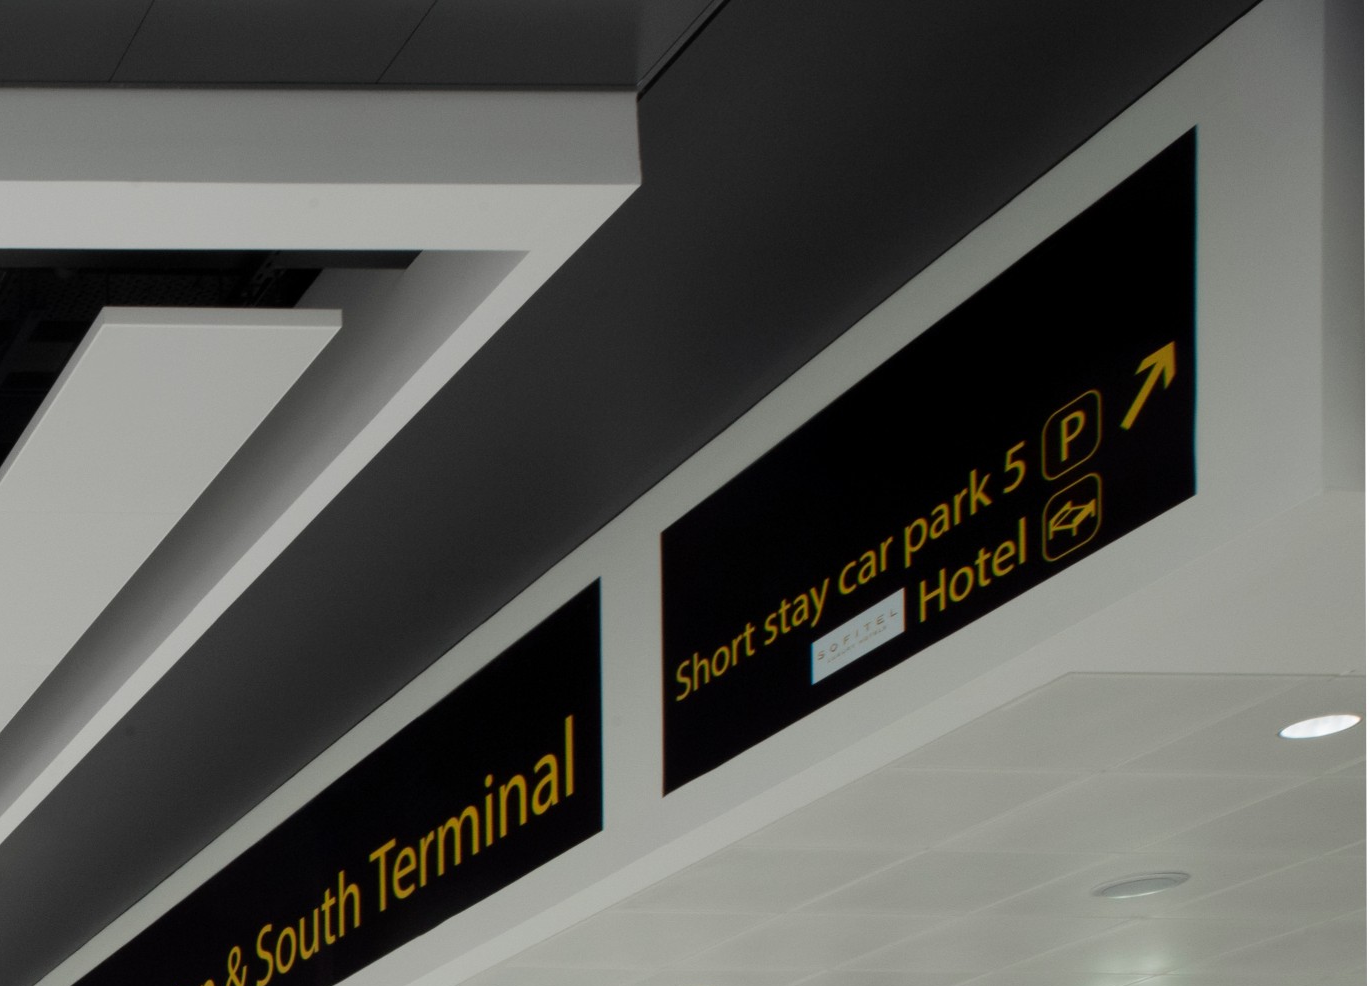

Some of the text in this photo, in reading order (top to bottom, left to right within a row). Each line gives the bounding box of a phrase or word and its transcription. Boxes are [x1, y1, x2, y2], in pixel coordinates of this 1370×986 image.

[676, 623, 756, 701] Short
[764, 578, 830, 647] stay
[838, 536, 893, 596] car
[904, 469, 993, 569] park
[1003, 441, 1026, 494] 5
[817, 516, 1028, 661] SOFITEL Hotel
[369, 715, 576, 912] Terminal
